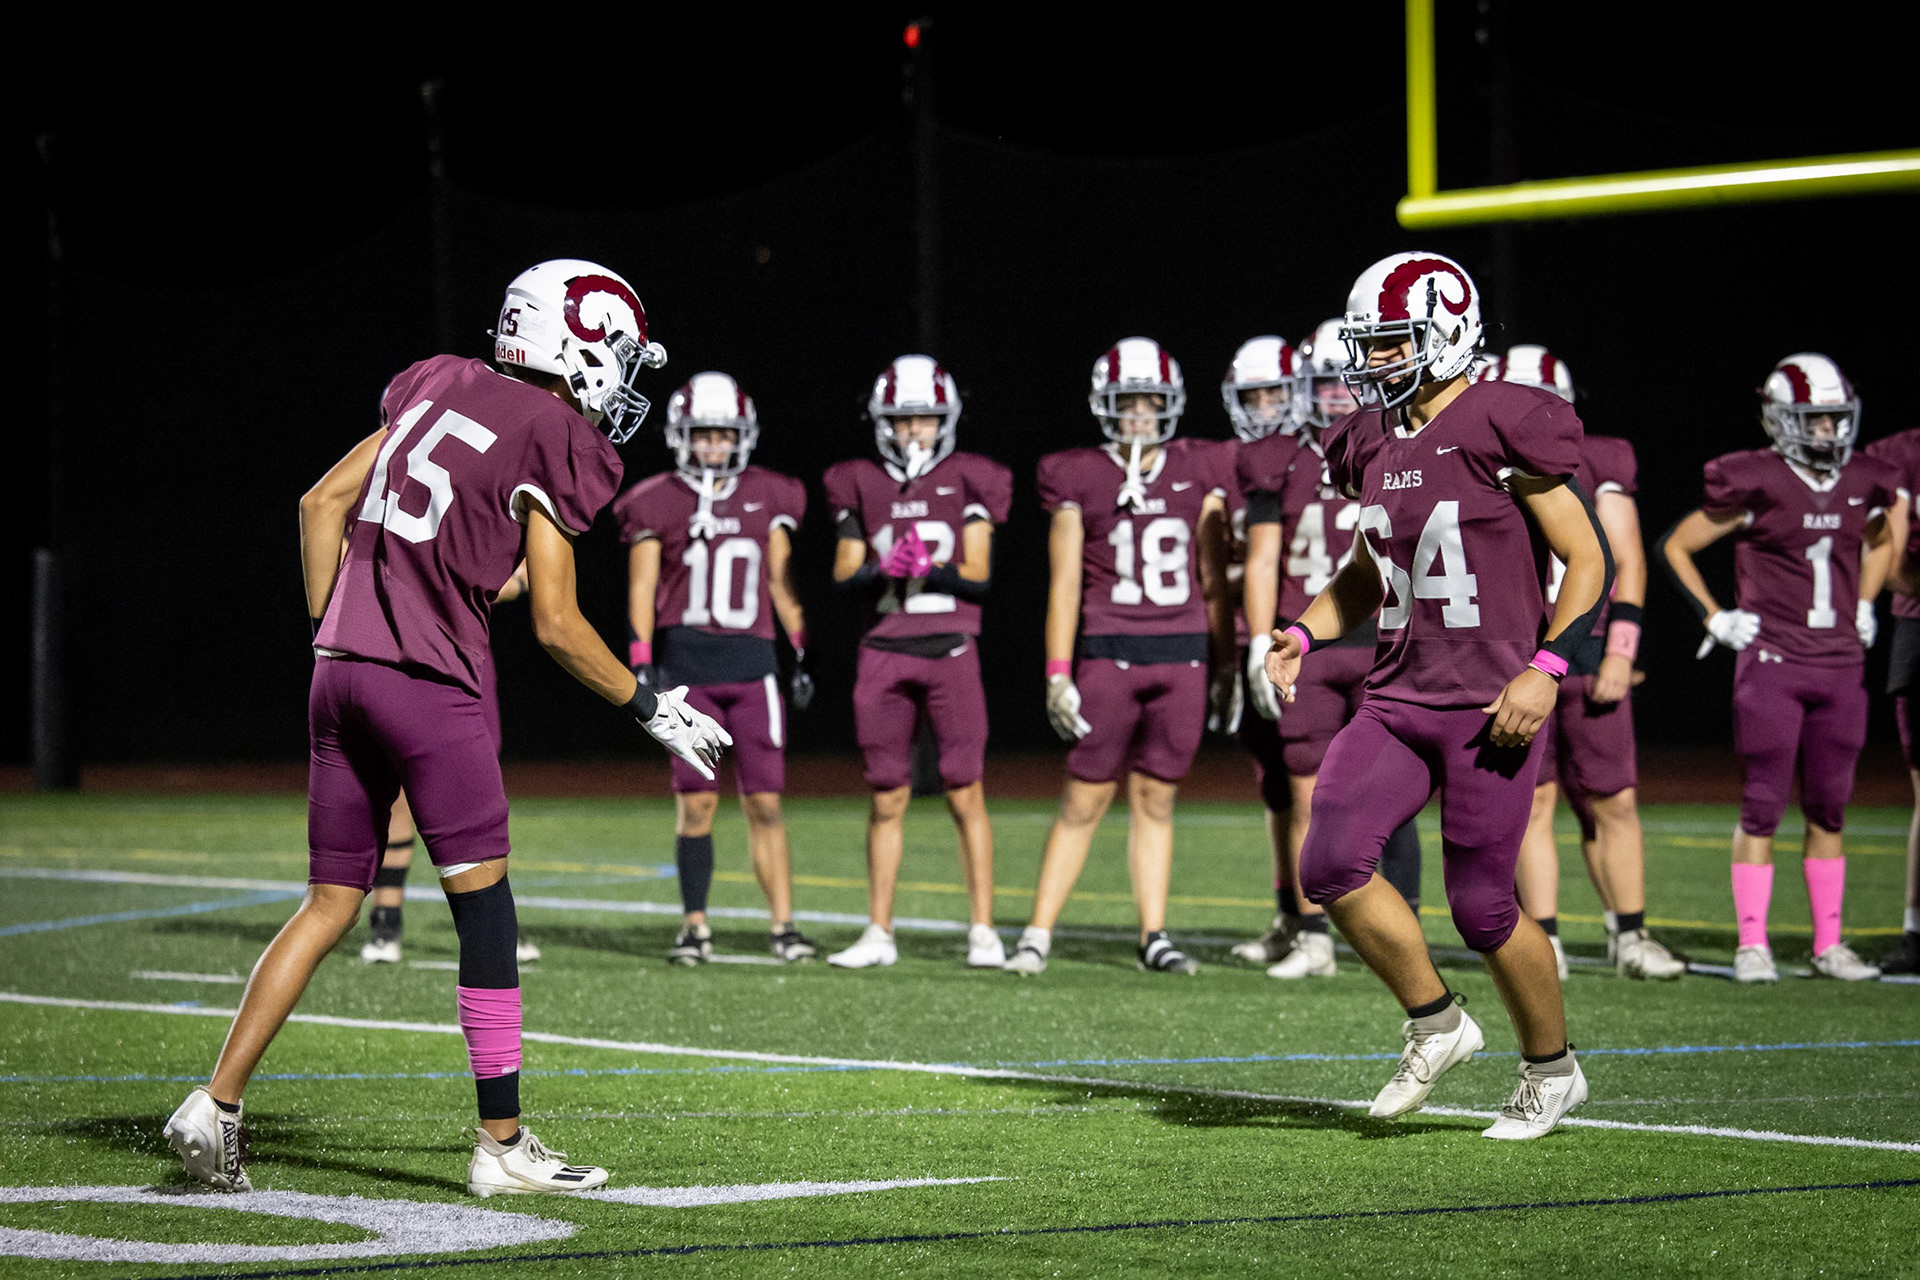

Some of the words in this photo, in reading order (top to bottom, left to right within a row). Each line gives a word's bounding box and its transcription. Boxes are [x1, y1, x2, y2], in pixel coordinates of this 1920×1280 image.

[357, 399, 499, 544] 15
[1382, 469, 1423, 490] RAMS
[1107, 517, 1190, 606] 18
[1359, 500, 1480, 630] 64
[1803, 513, 1841, 530] RAMS
[681, 537, 762, 629] 10
[1805, 535, 1837, 629] 1
